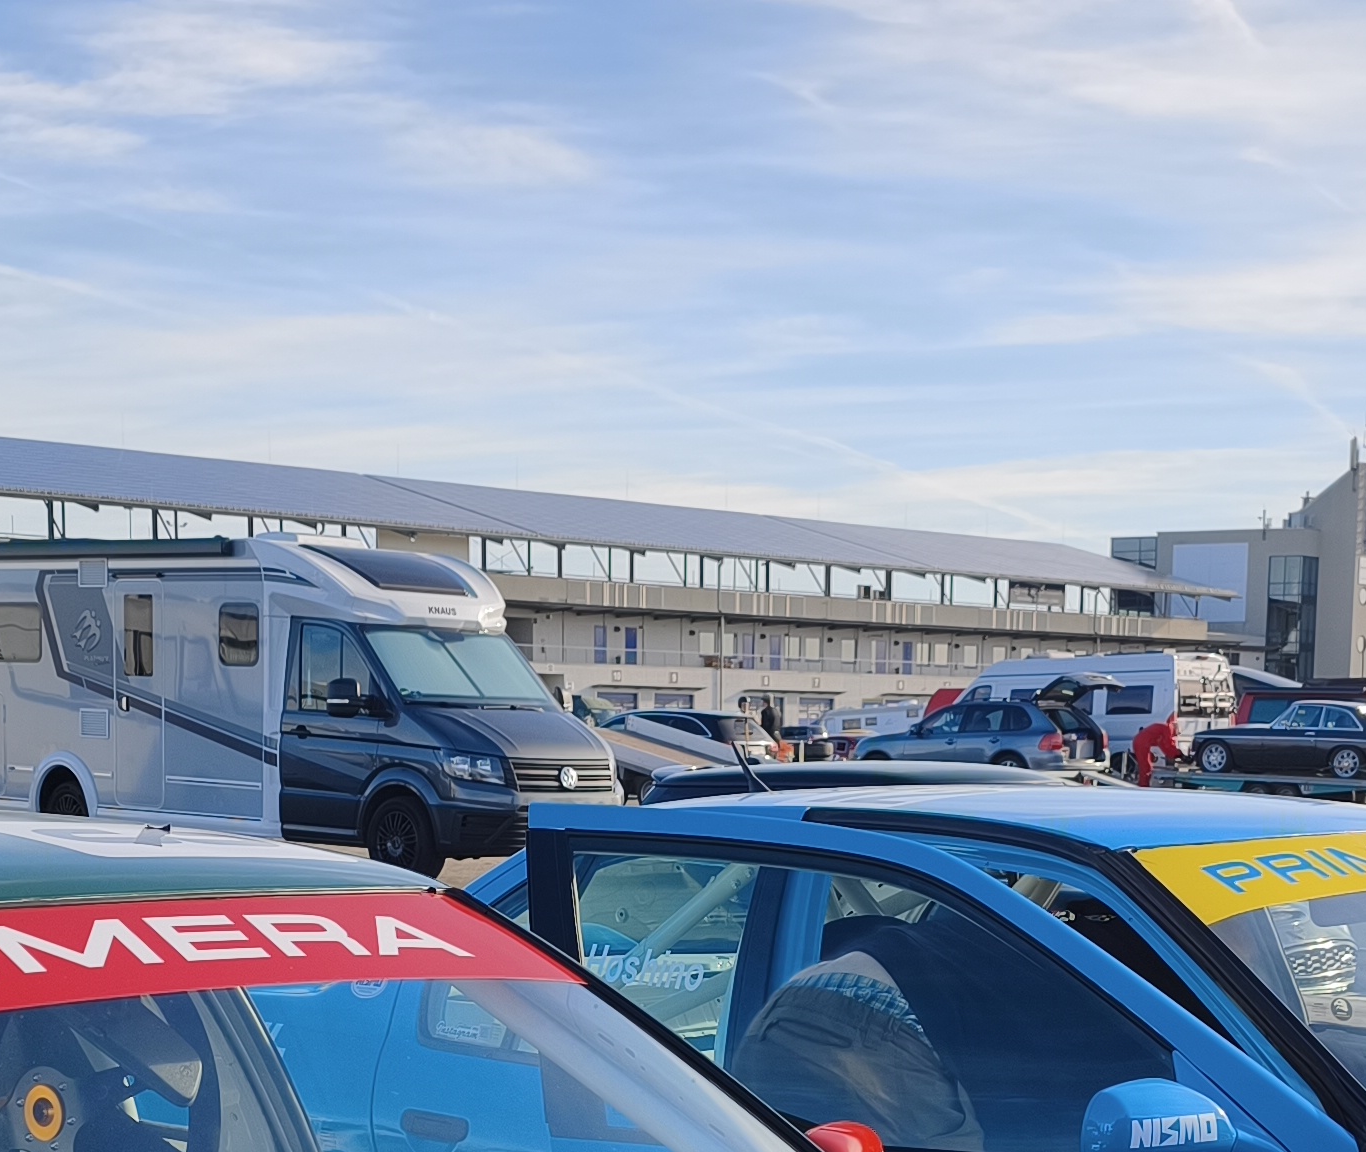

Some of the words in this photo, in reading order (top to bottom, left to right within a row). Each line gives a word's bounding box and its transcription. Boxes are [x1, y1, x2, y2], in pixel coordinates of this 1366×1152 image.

[427, 605, 458, 617] KNAUS
[586, 943, 704, 992] Hoshino
[1129, 1111, 1219, 1149] NISMO
